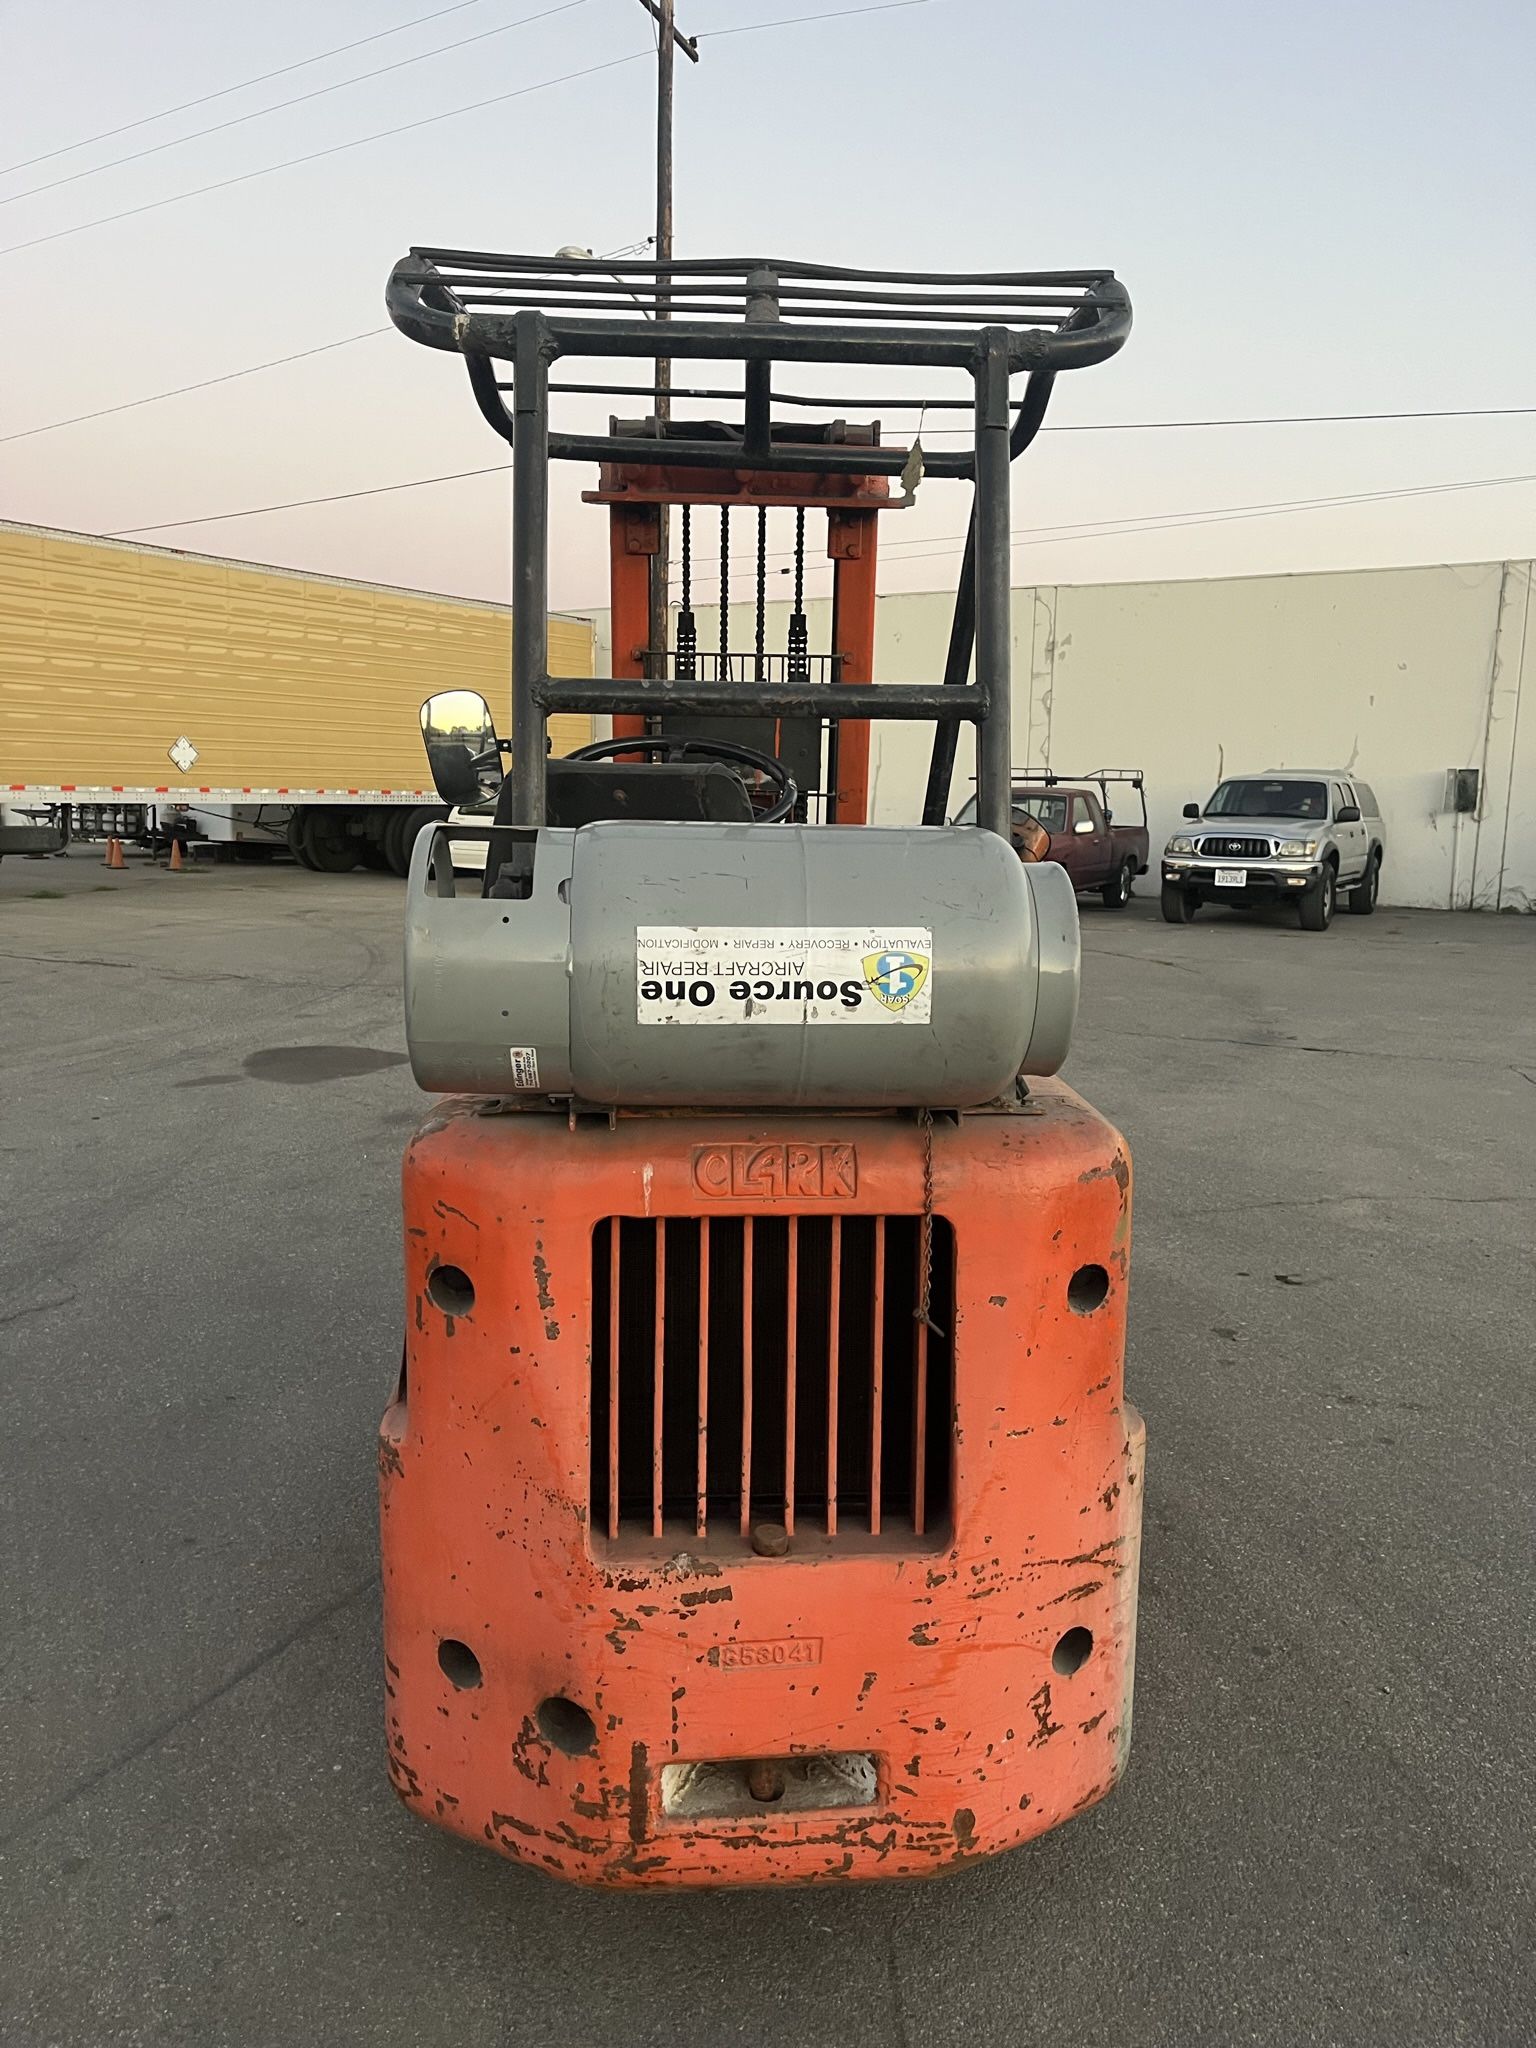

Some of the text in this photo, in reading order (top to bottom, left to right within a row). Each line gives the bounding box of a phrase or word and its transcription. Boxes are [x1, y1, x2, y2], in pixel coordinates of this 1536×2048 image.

[637, 939, 931, 949] EVALUATION RECOVERY REPAIR MODIFICATION
[641, 961, 805, 976] AIRCRAFT REPAIR
[640, 980, 862, 1008] Source One
[880, 992, 911, 1006] SOAR
[514, 1059, 524, 1087] Edinger
[694, 1144, 856, 1197] CLARK
